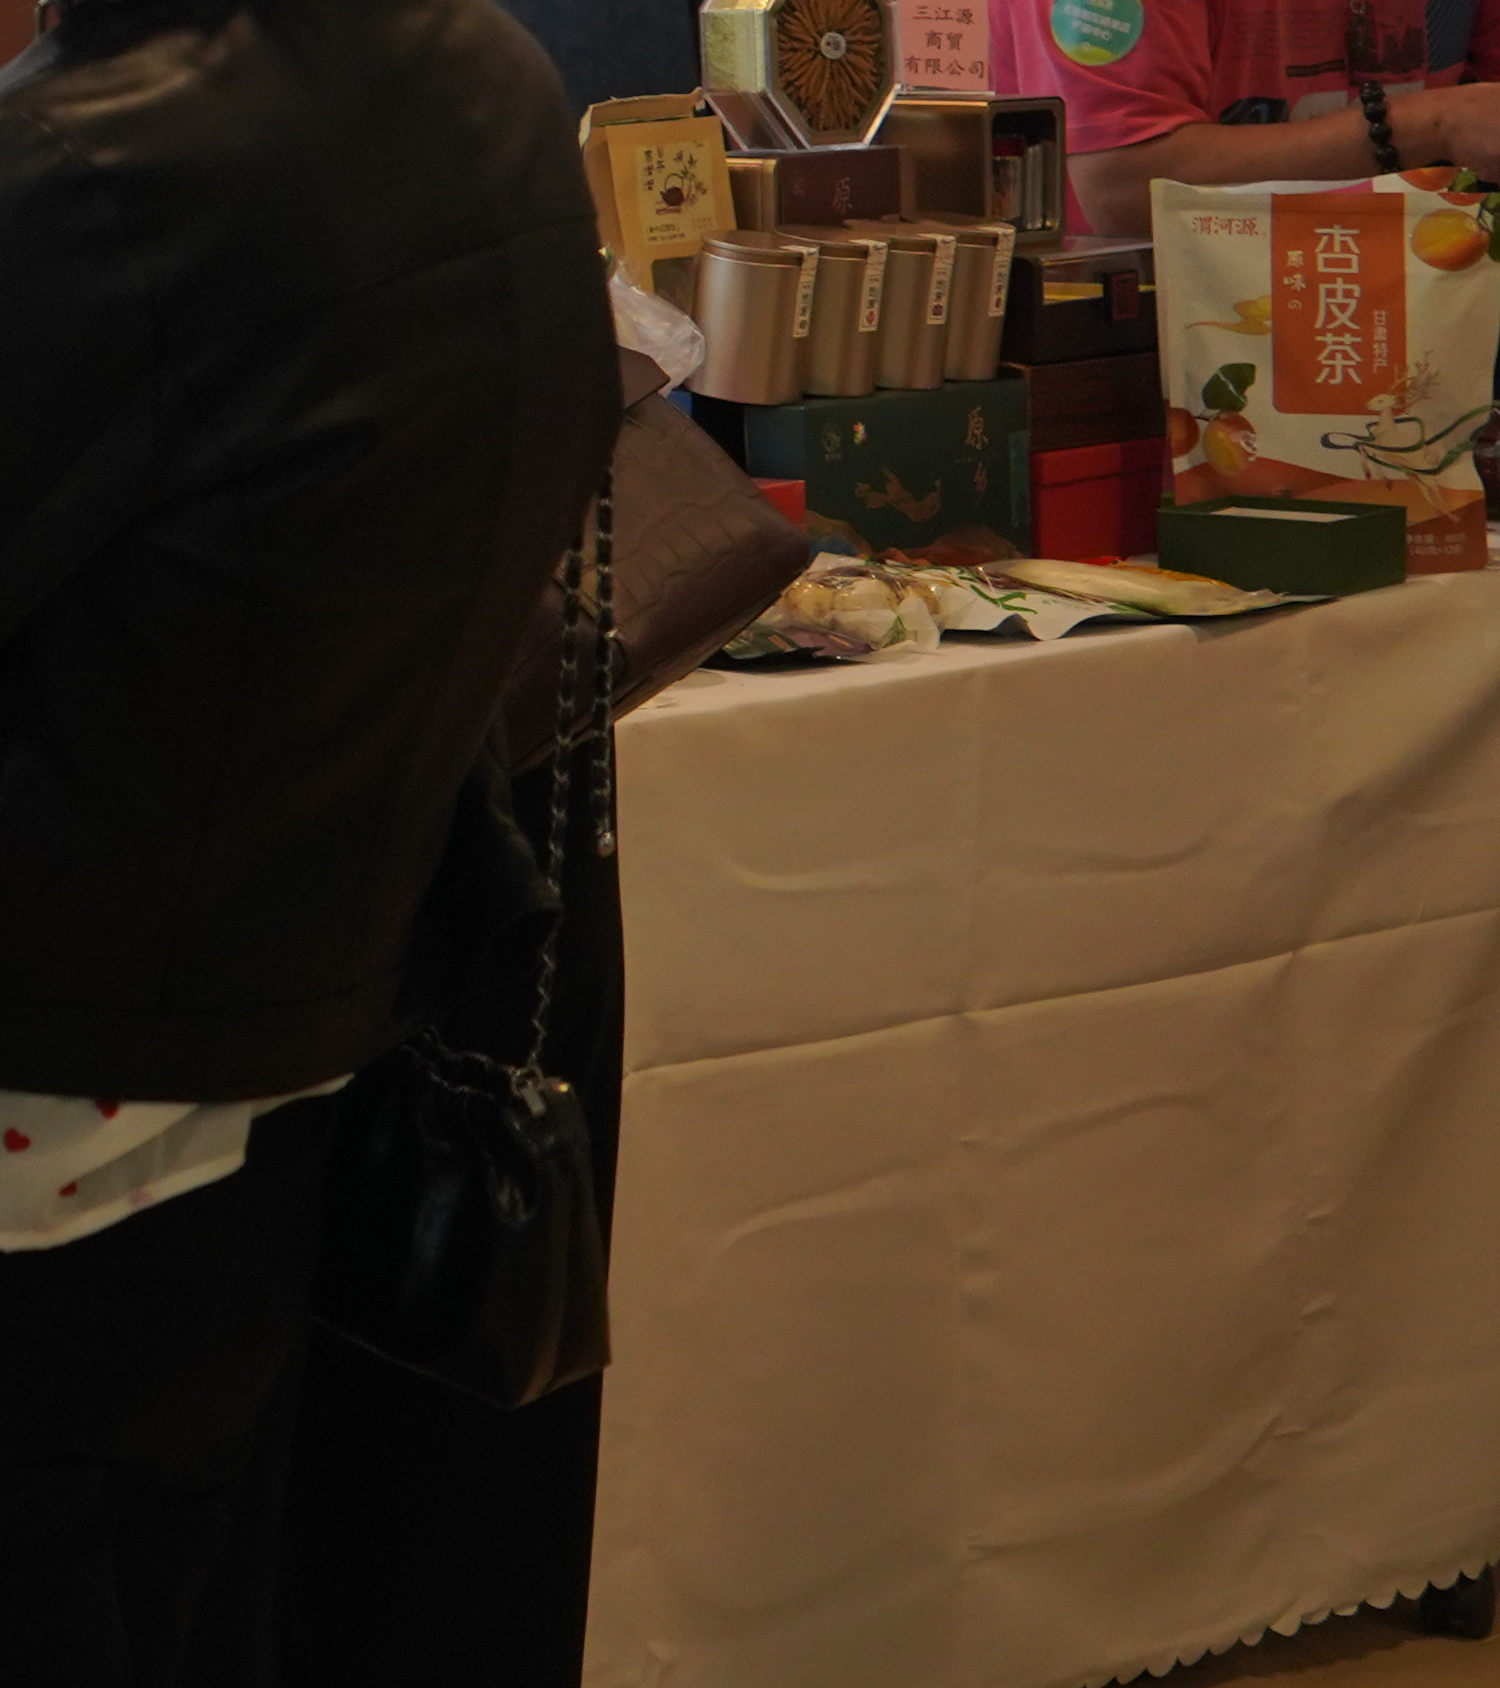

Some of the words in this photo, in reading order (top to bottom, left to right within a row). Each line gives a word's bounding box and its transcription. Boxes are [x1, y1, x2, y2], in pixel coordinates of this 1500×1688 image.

[912, 4, 975, 26] 三江源
[904, 56, 985, 78] 有限公司
[1281, 250, 1308, 312] 原味の
[1313, 224, 1365, 386] 杏皮茶
